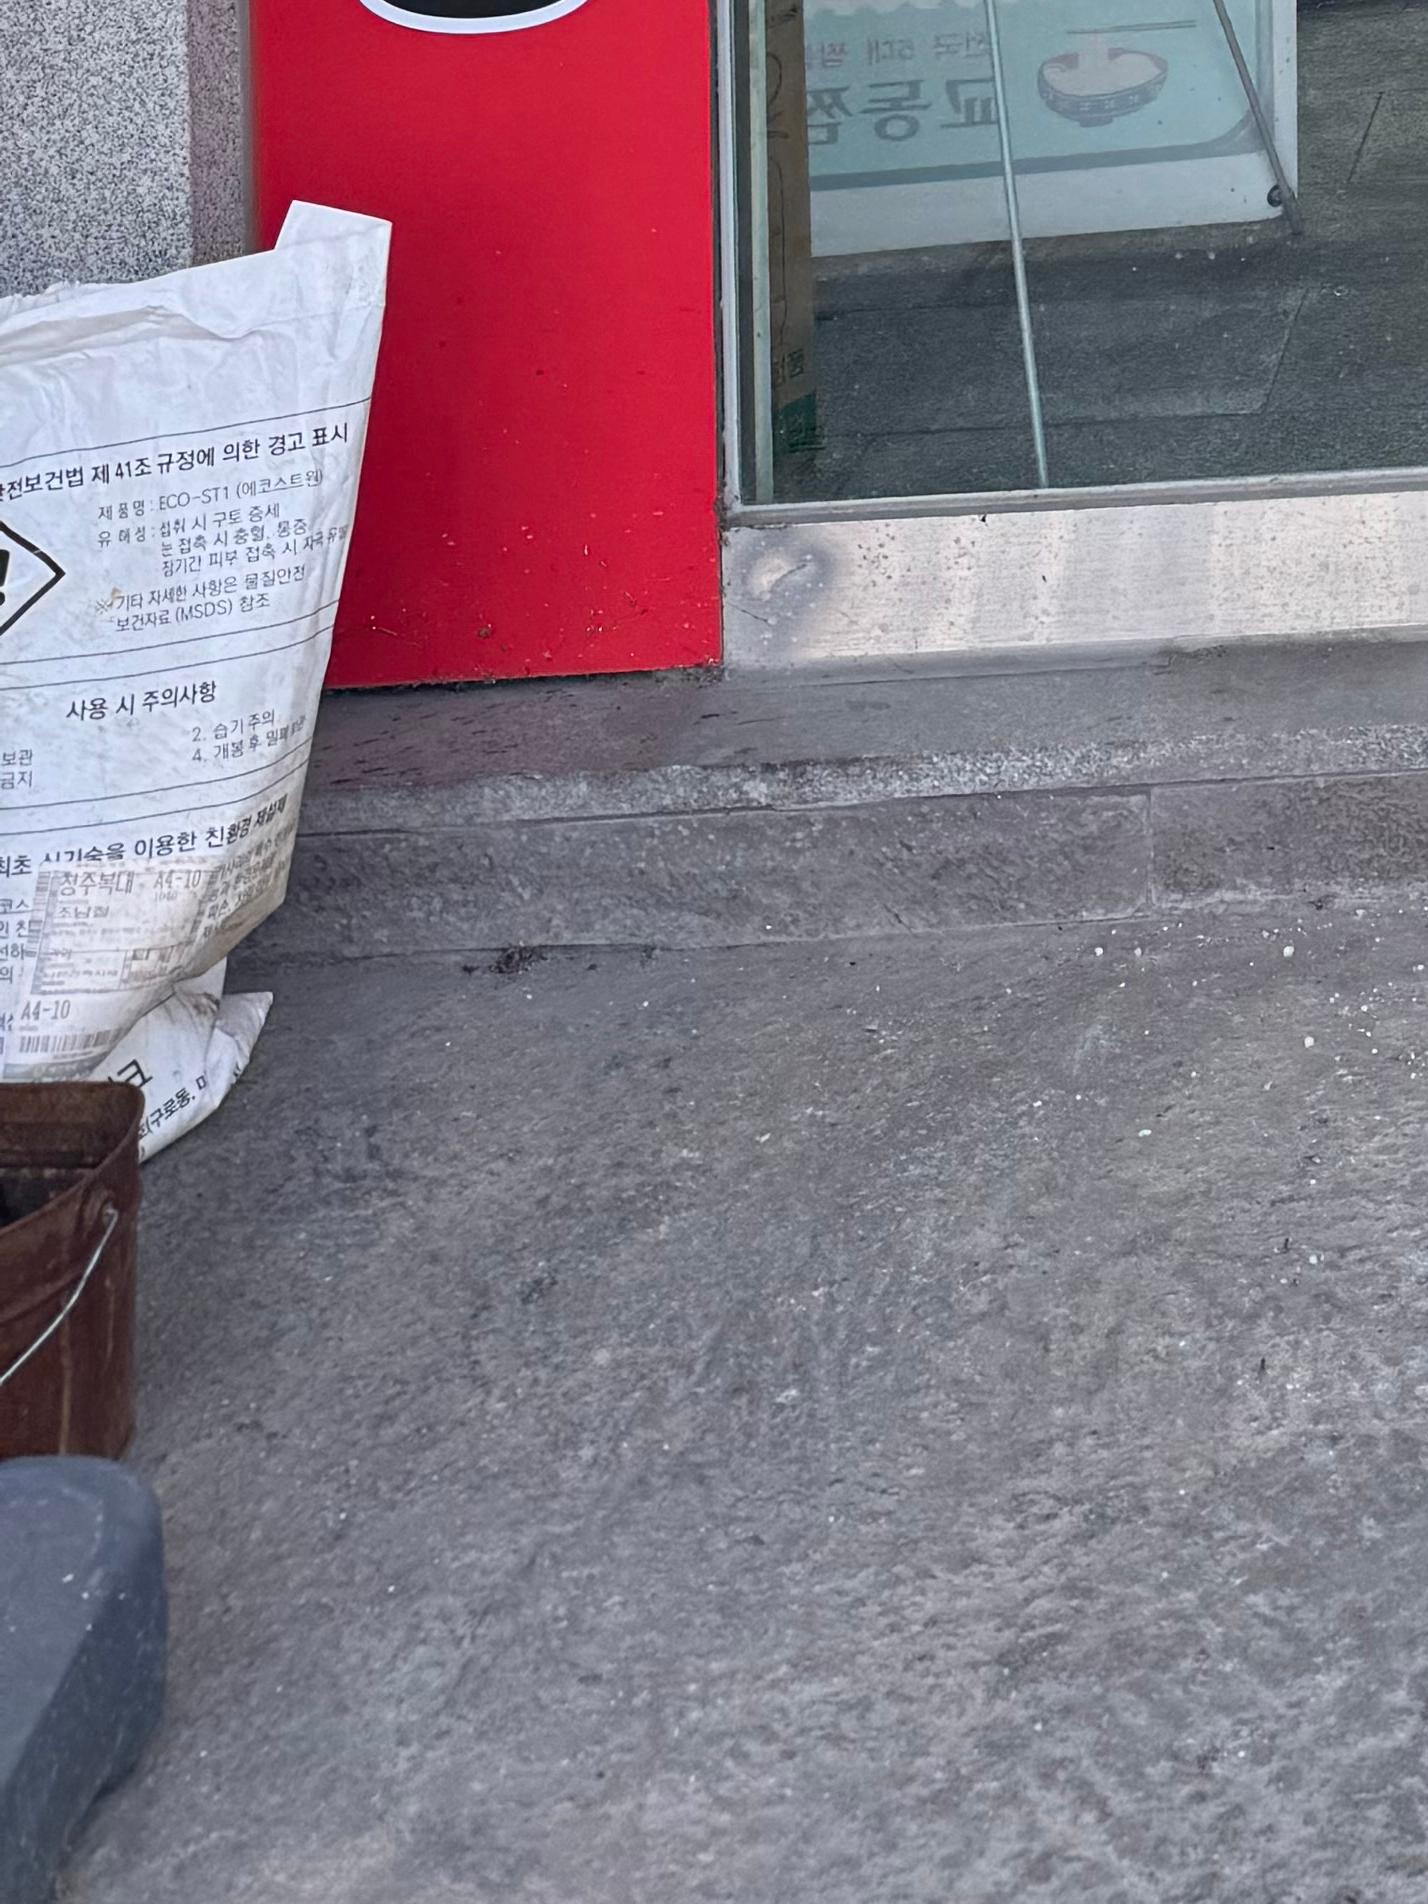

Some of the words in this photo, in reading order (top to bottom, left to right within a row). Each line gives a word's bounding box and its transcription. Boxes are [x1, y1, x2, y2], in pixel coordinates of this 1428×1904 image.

[157, 445, 216, 475] 규정에
[222, 438, 261, 463] 의한
[267, 431, 306, 457] 경고
[310, 422, 349, 448] 표시
[158, 485, 230, 512] ECO-ST1
[65, 697, 108, 722] 사용
[114, 692, 136, 717] 시
[141, 680, 217, 712] 주의사항
[134, 830, 197, 860] 이용한
[19, 999, 72, 1022] A4-10
